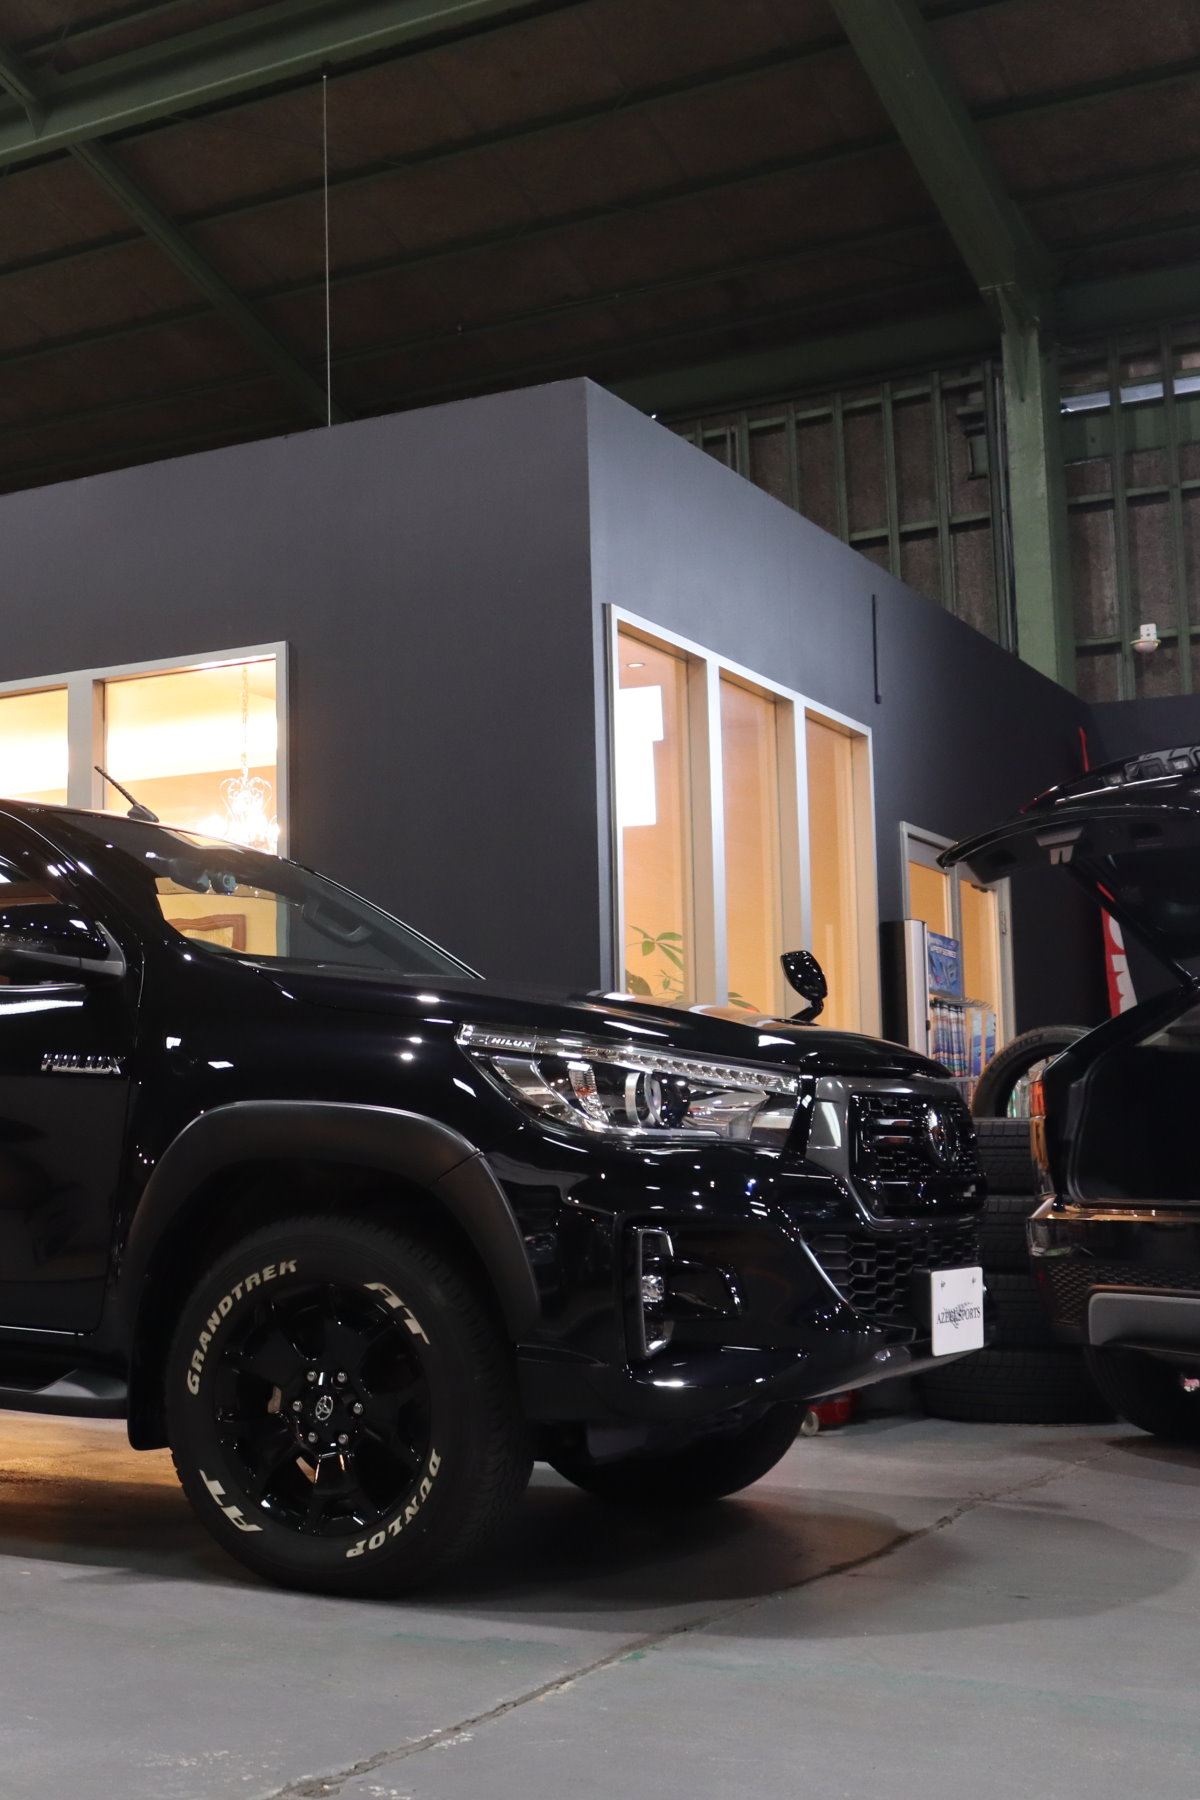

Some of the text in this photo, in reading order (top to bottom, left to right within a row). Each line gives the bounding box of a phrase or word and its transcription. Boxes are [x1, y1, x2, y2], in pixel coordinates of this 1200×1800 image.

[491, 1037, 532, 1048] HILUX
[187, 1259, 298, 1395] GRANDTREK
[363, 1282, 430, 1345] AT
[200, 1469, 263, 1531] AT
[346, 1448, 441, 1558] DUNLOP
